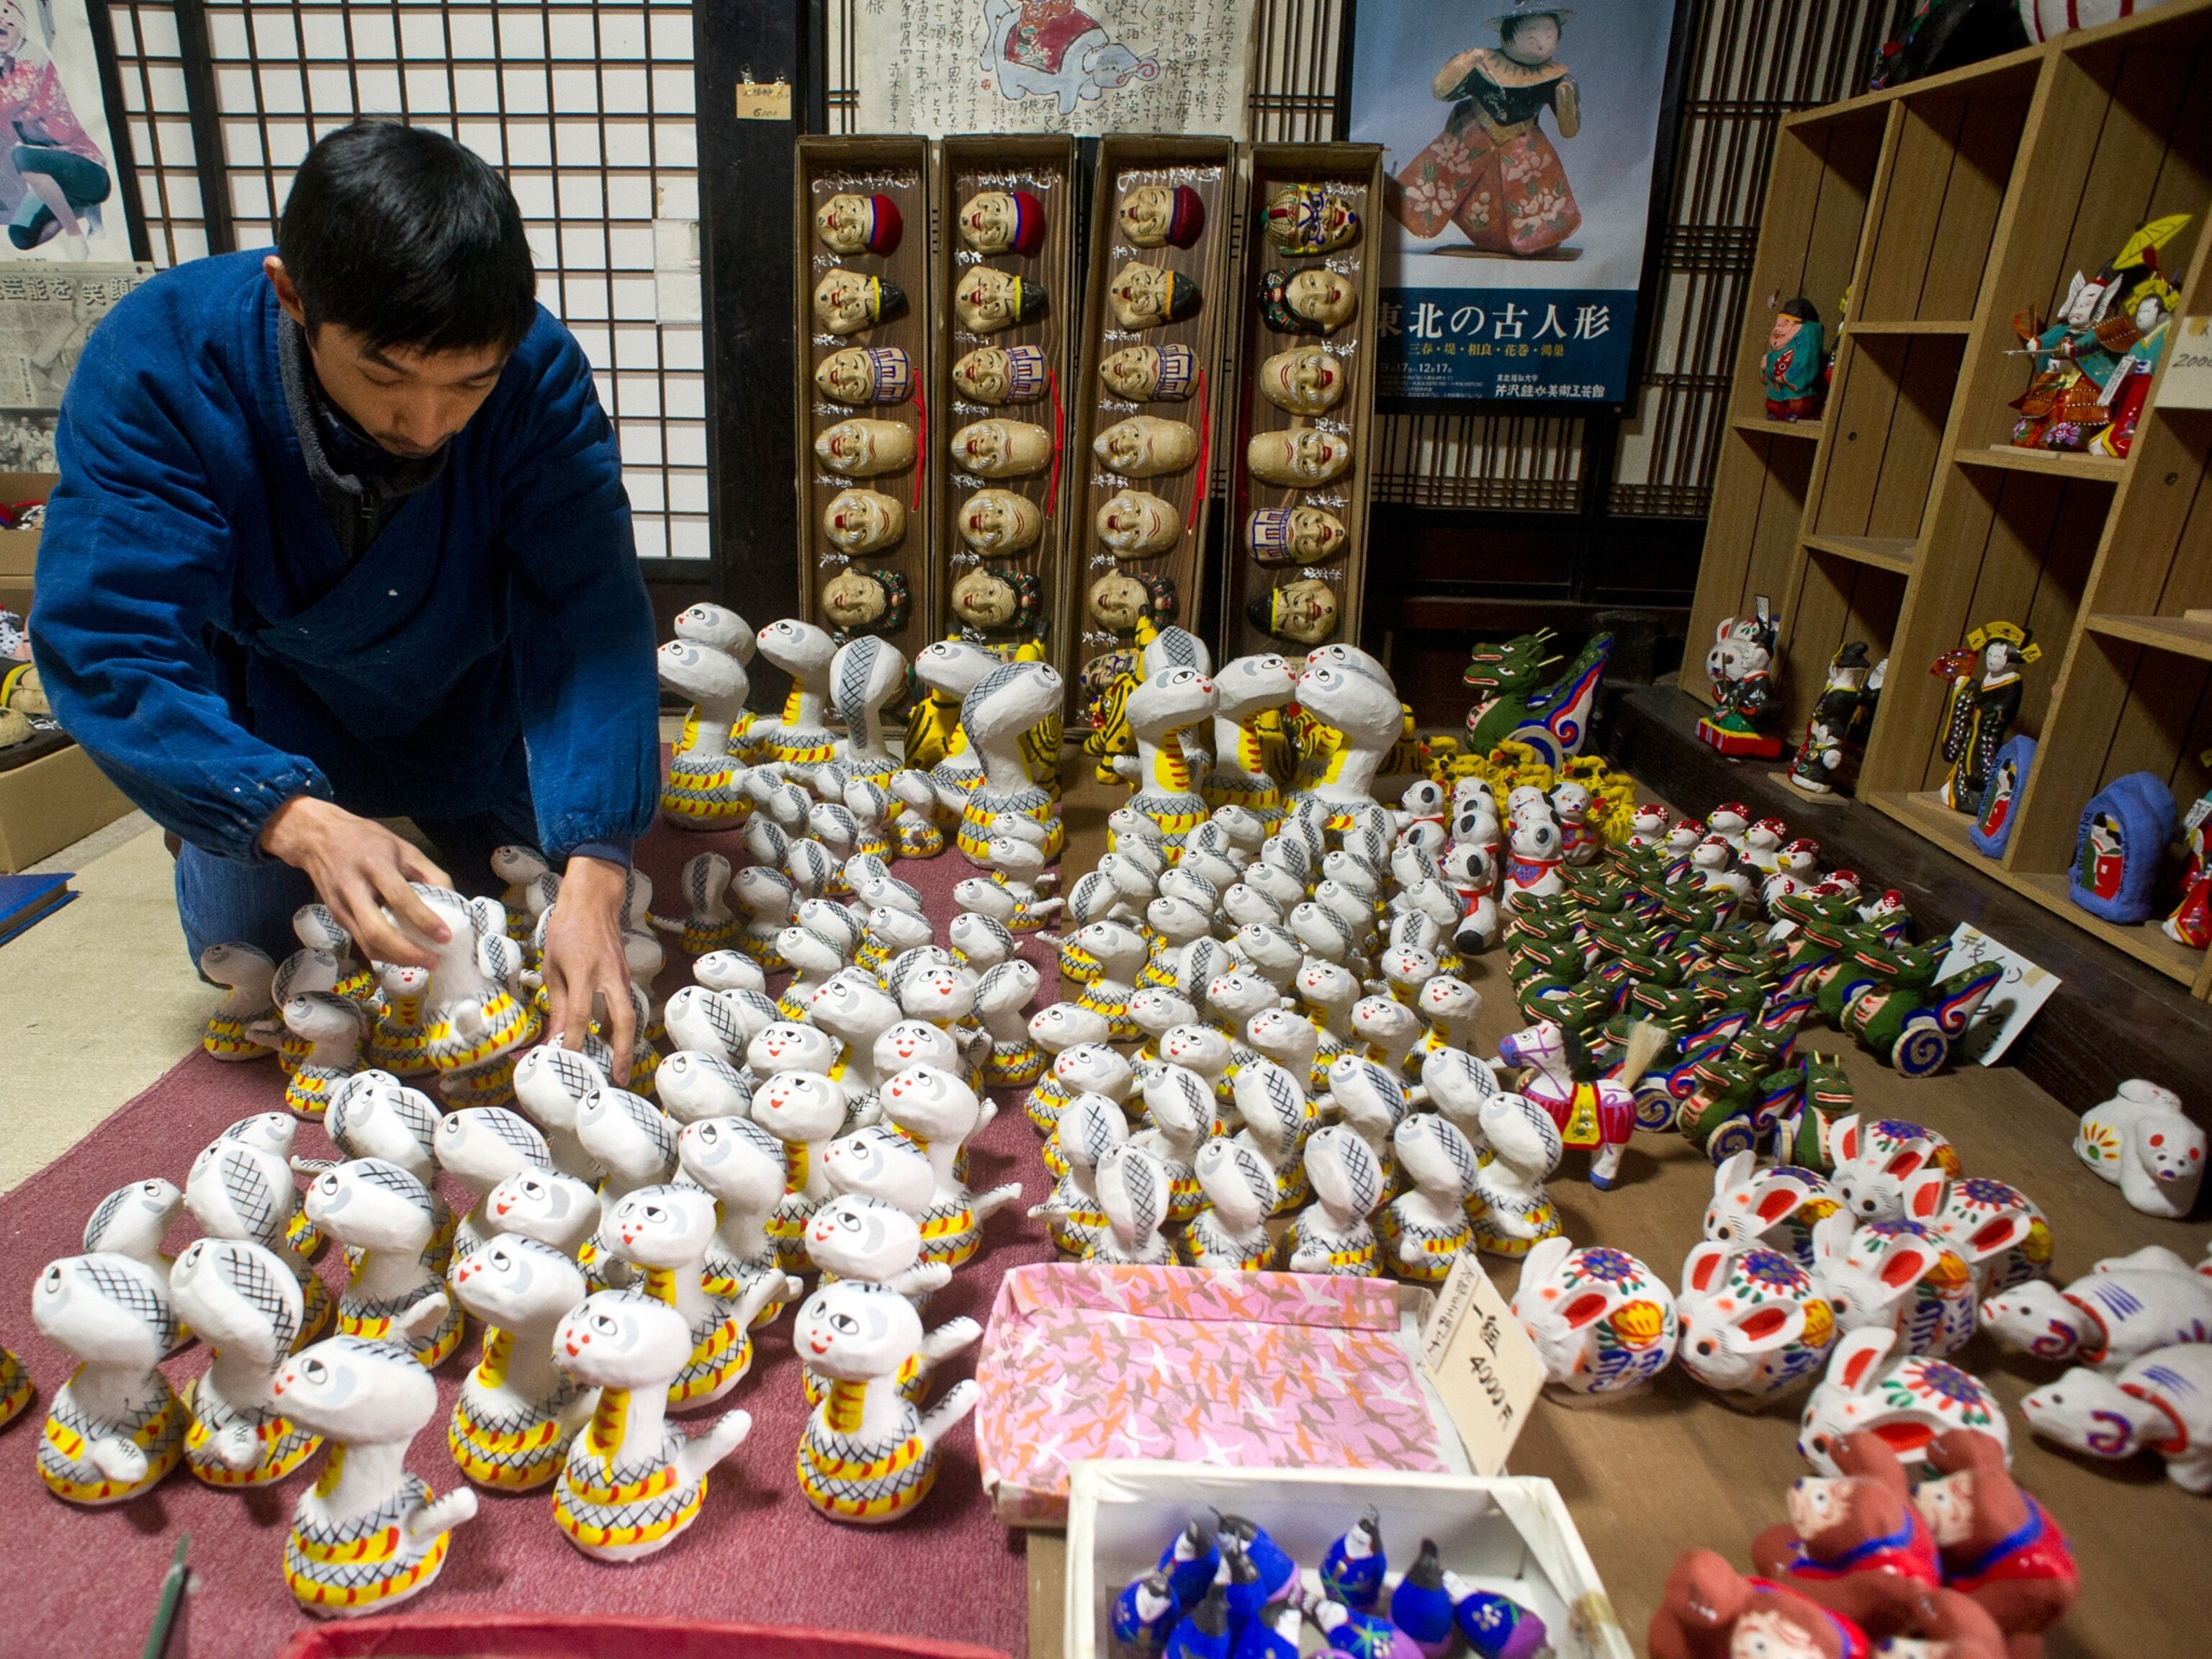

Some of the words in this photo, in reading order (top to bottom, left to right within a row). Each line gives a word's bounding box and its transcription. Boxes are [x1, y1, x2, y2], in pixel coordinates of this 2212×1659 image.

[0, 276, 145, 306] 芸能を笑顔
[1377, 301, 1610, 340] 東北の古人形
